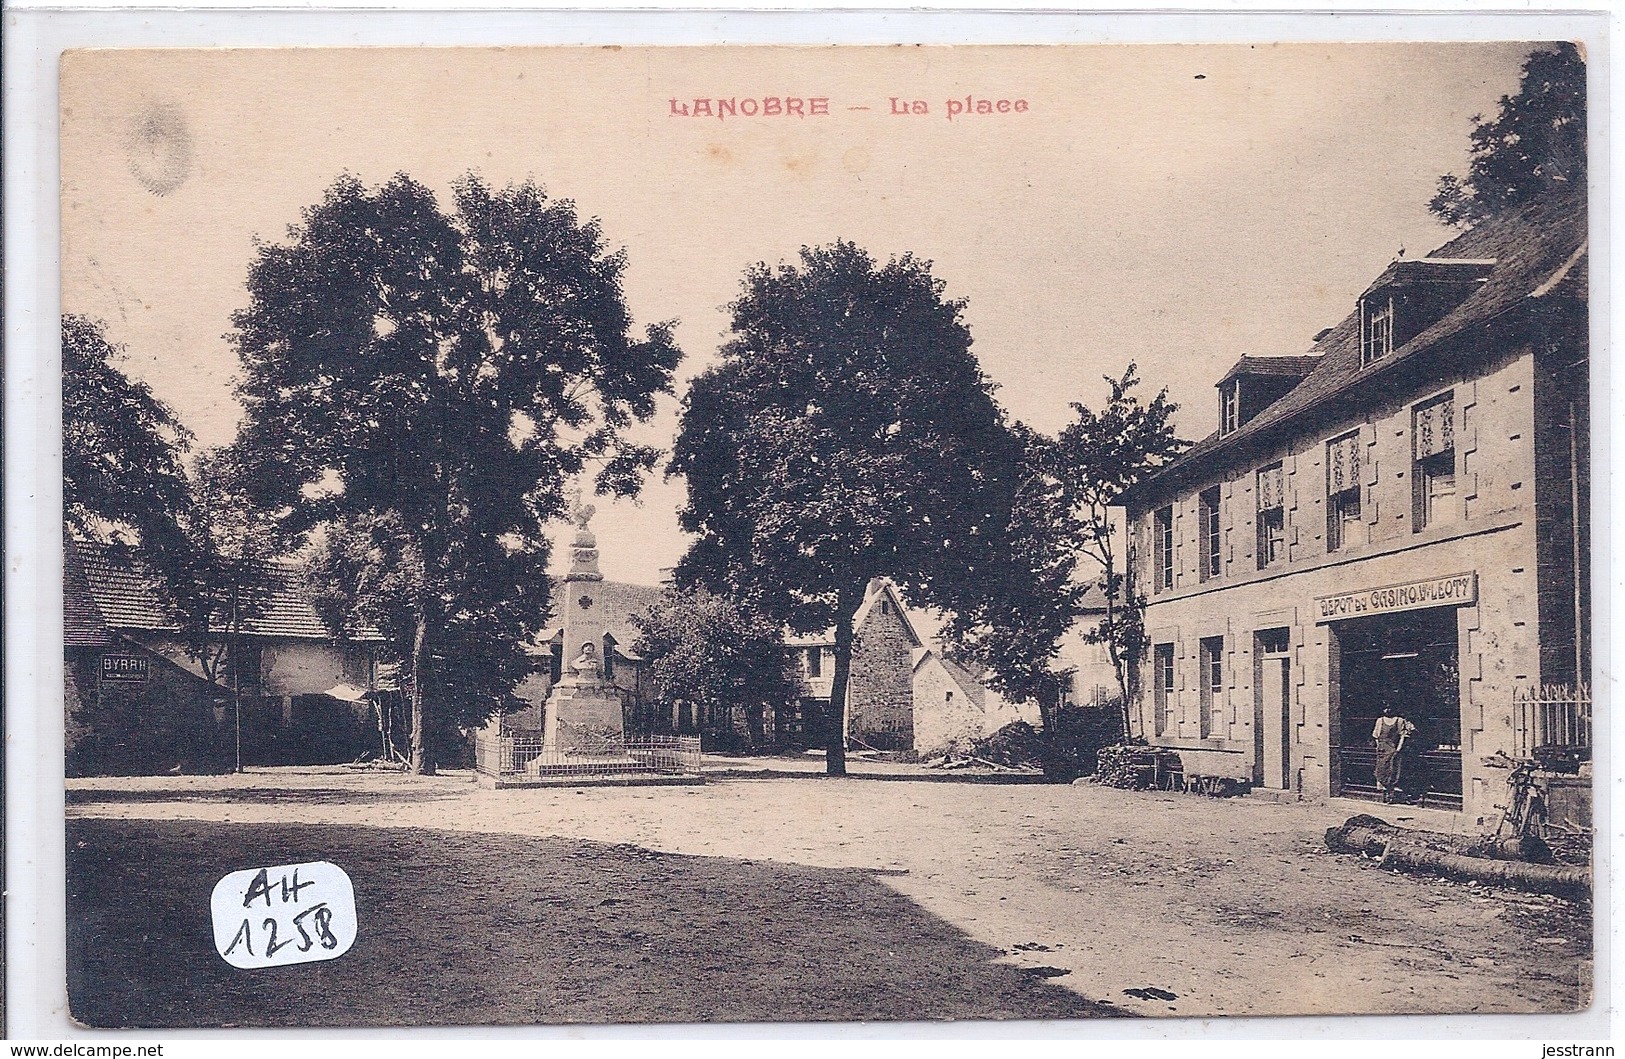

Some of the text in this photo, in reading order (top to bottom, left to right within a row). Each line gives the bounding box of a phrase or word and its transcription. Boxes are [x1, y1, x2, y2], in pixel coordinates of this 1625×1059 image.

[668, 96, 830, 121] LANOBRE
[888, 96, 929, 115] La
[945, 94, 1029, 121] place
[103, 658, 146, 671] BYRRH
[242, 867, 315, 908] AH
[223, 902, 338, 958] 1258
